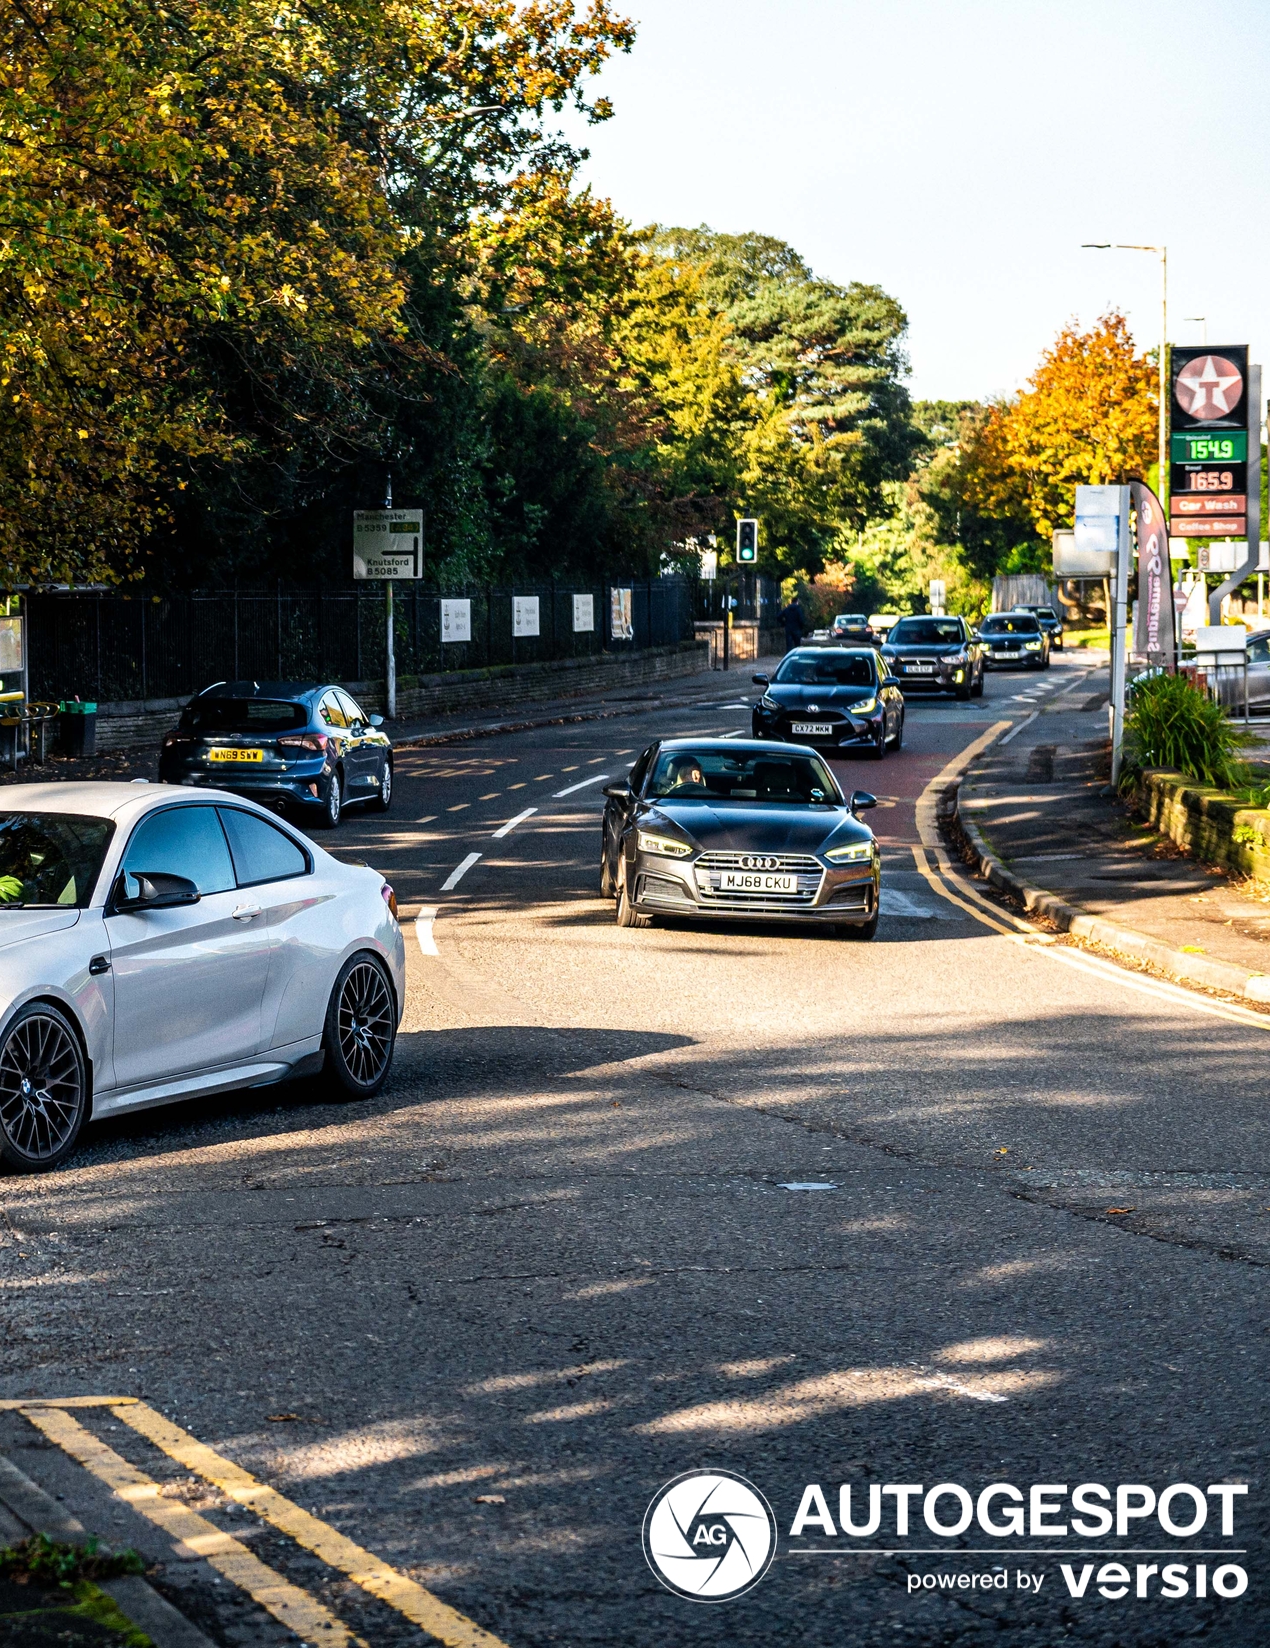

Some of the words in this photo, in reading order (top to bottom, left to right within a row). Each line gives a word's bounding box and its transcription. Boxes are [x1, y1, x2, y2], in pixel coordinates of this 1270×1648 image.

[1190, 471, 1233, 490] 165.9
[1179, 500, 1202, 511] Car
[1204, 500, 1238, 510] Wash
[356, 512, 406, 520] Manchester
[1178, 522, 1210, 531] Coffee
[1212, 521, 1238, 532] Shop
[367, 558, 409, 566] Knutsford
[726, 875, 762, 888] MJ68
[765, 877, 791, 889] CKU
